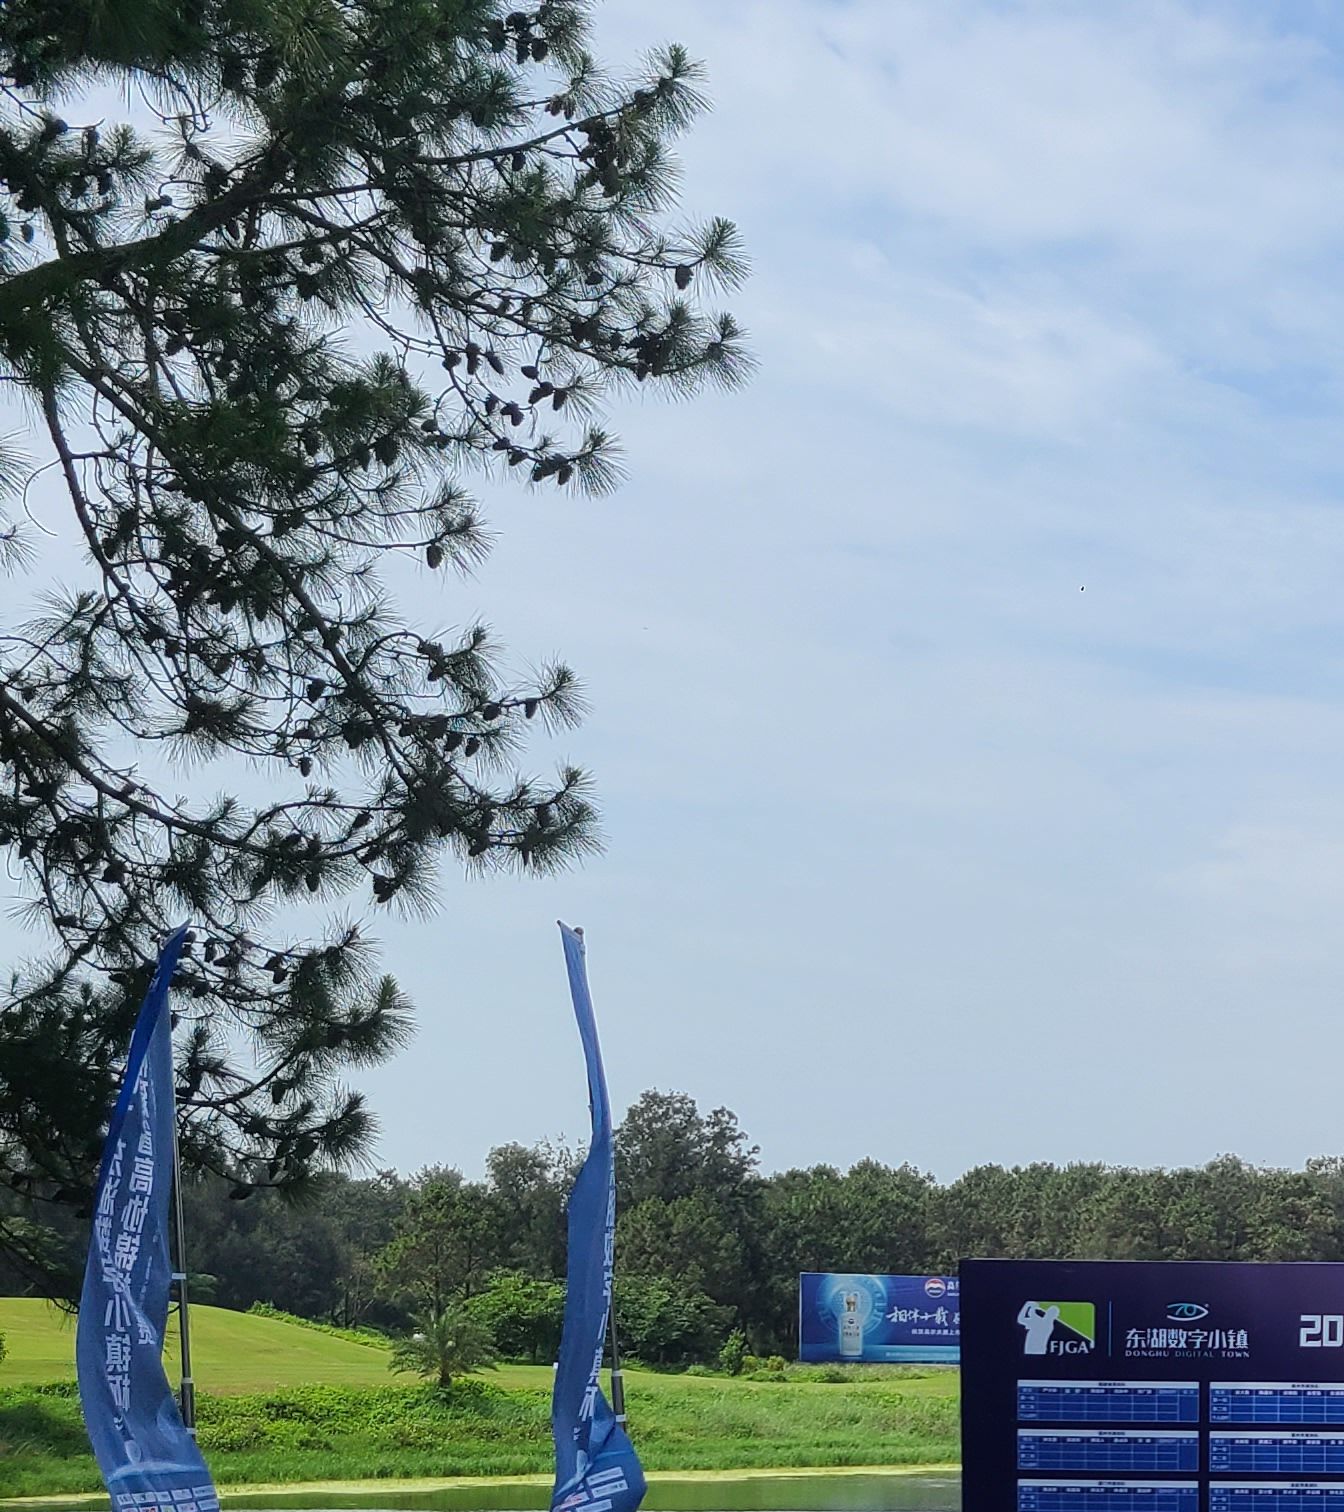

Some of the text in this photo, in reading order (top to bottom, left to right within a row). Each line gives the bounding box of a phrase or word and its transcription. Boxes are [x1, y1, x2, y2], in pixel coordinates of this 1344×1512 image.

[1125, 1328, 1249, 1349] 东湖数字小镇
[1050, 1341, 1089, 1355] FJGA
[1125, 1350, 1250, 1358] DONGHU DIGITAL TOWN
